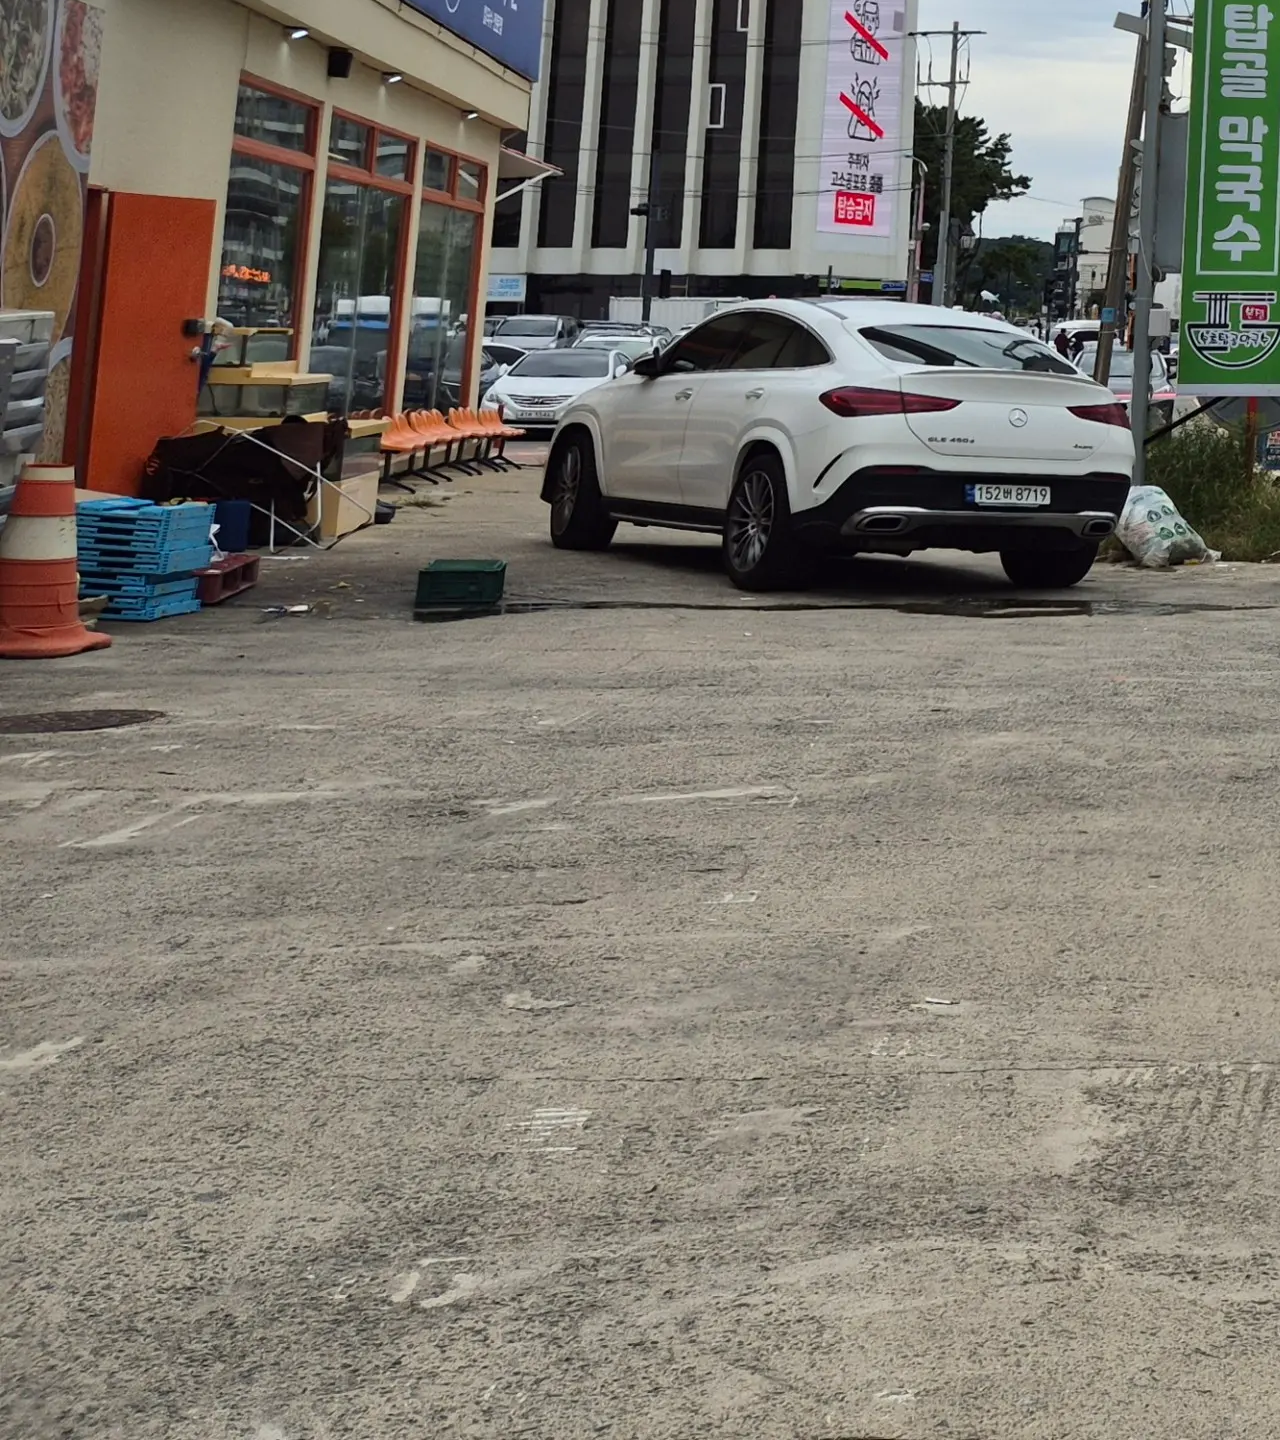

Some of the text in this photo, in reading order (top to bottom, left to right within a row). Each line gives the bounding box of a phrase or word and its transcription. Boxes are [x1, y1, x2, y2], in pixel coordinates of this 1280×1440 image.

[1220, 3, 1273, 99] 탑골
[830, 171, 867, 192] 고소공포증
[1212, 115, 1269, 262] 막국수
[837, 195, 873, 222] 탑승금지
[1245, 305, 1265, 320] 본점
[977, 486, 1048, 502] 152버 8719
